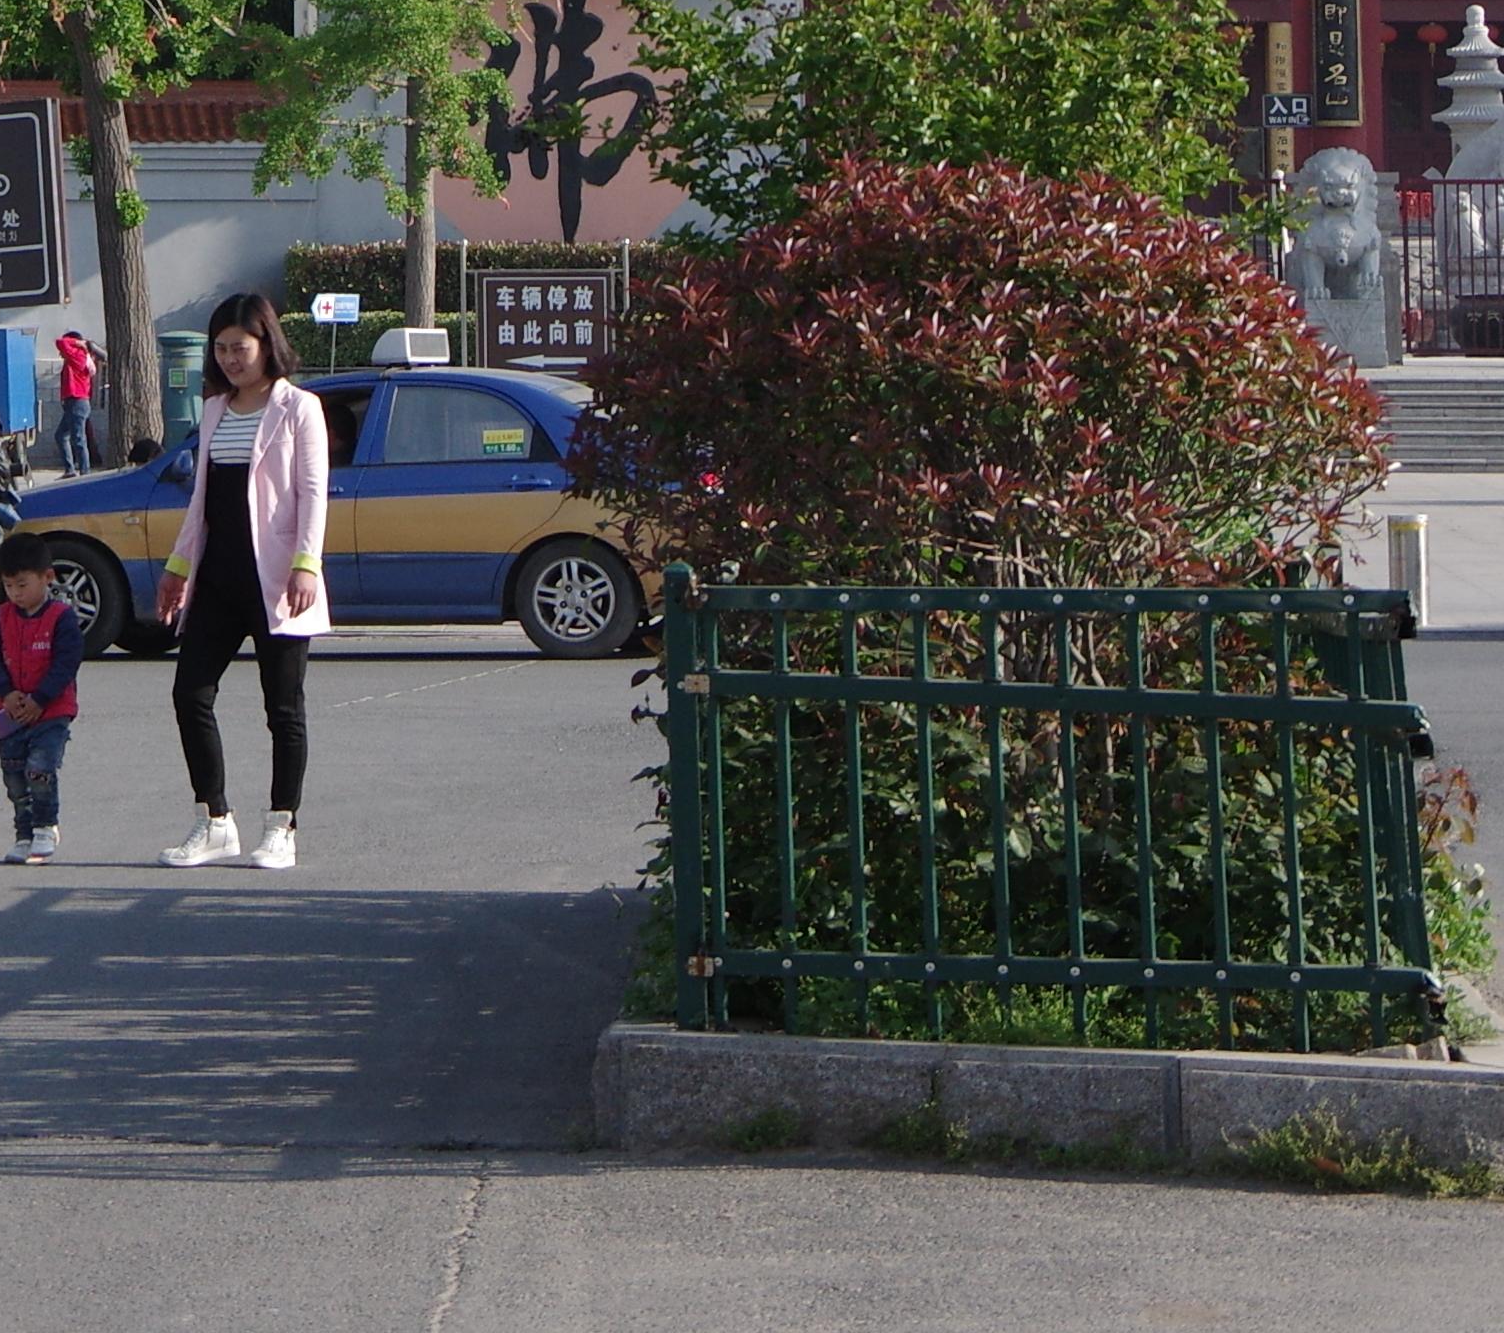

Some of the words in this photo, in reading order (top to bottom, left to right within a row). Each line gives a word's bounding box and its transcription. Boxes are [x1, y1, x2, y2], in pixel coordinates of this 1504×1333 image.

[1269, 97, 1307, 114] 入口
[1269, 116, 1287, 124] WAY
[496, 285, 594, 312] 车辆停放
[498, 319, 594, 346] 由此向前
